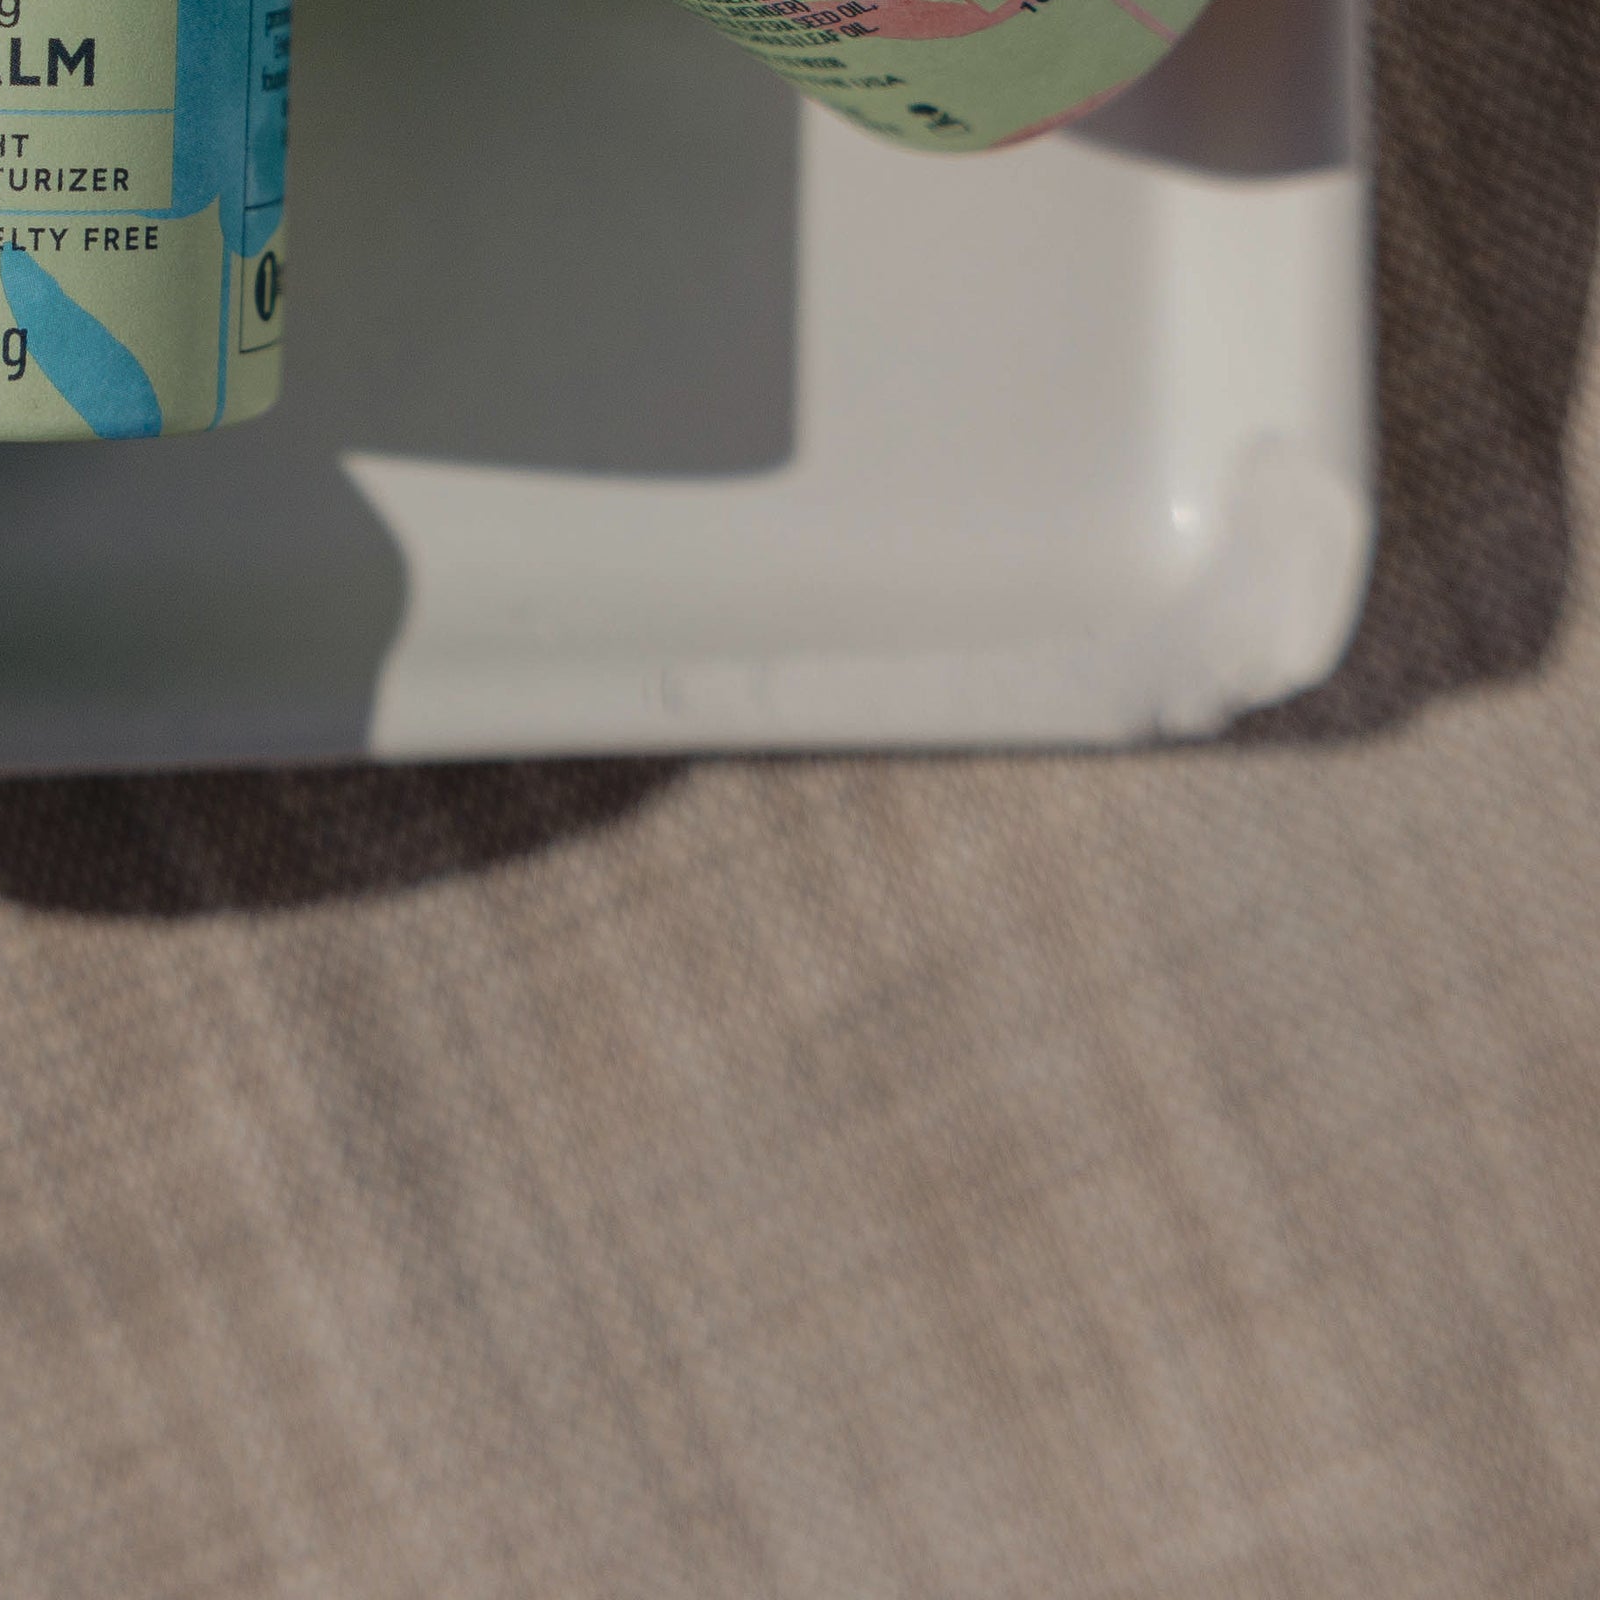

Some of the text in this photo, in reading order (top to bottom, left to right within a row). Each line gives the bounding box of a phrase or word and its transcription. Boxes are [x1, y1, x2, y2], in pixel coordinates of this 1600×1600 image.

[791, 9, 842, 30] SEED
[85, 226, 158, 251] FREE
[3, 328, 27, 381] g
